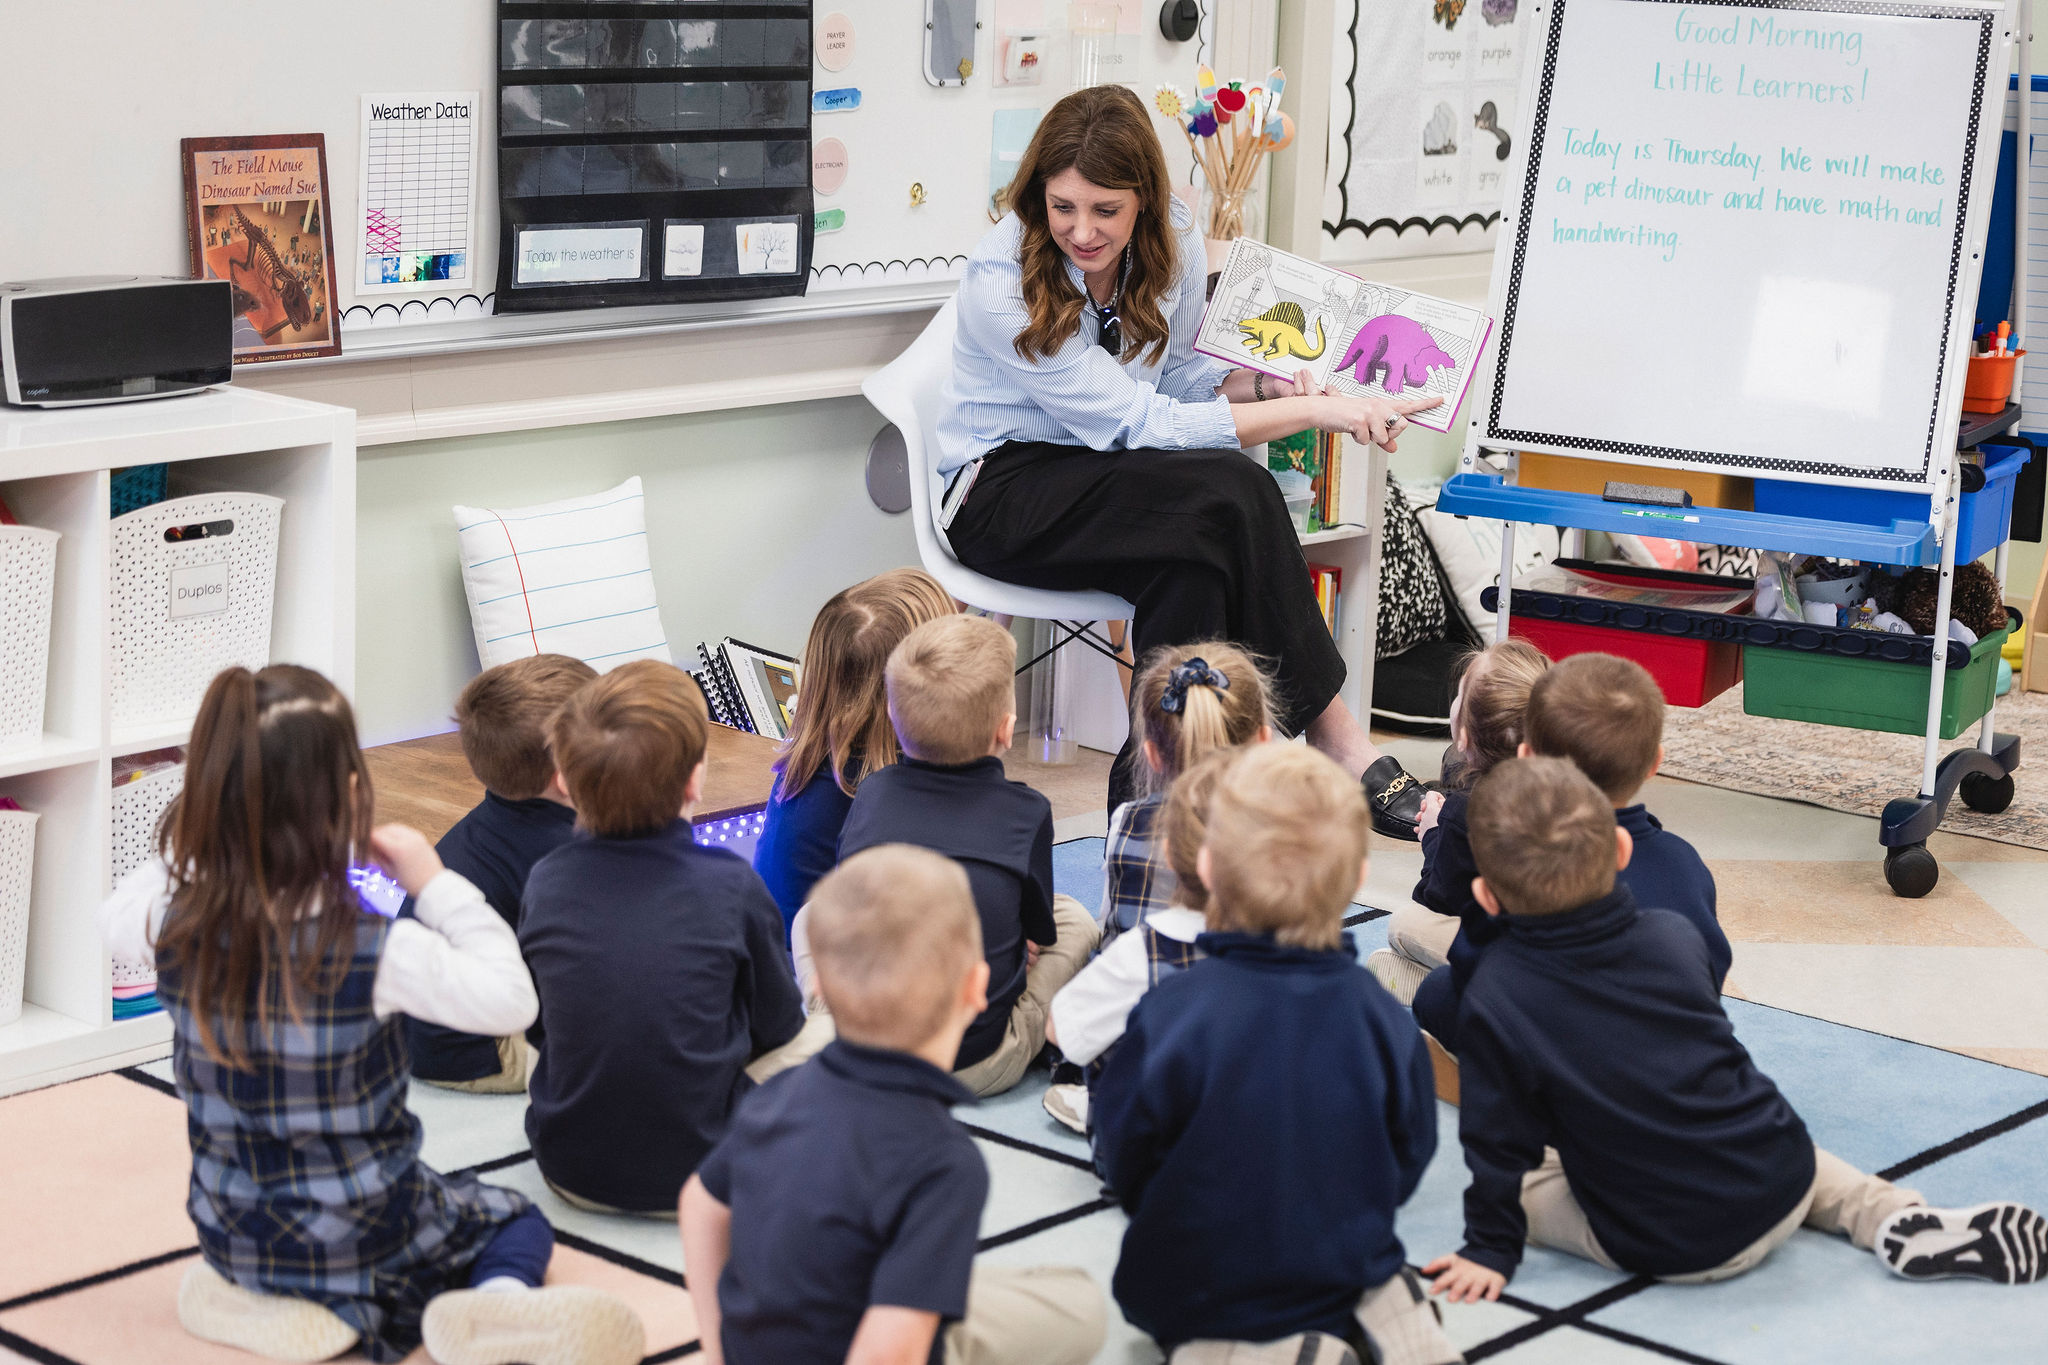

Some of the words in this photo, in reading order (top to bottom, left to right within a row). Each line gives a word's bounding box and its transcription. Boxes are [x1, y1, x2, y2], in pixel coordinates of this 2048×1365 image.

[826, 42, 846, 50] LEADER
[1675, 7, 1740, 45] Good
[1749, 16, 1863, 66] Morning
[1428, 51, 1462, 69] orange
[1482, 42, 1512, 66] purple
[1653, 59, 1723, 95] Little
[1737, 64, 1869, 112] Learners!
[371, 102, 432, 120] Weather
[436, 101, 468, 119] Data
[824, 96, 848, 106] Cooper
[212, 157, 232, 176] The
[237, 155, 266, 175] Field
[268, 159, 304, 173] Mouse
[1562, 126, 1622, 171] Today
[1634, 139, 1654, 160] is
[1663, 138, 1766, 182] Thursday.
[1780, 146, 1812, 172] We
[1825, 154, 1870, 178] will
[1880, 161, 1945, 186] make
[815, 162, 844, 170] ELECTRICIAN
[1424, 168, 1453, 187] white
[1479, 171, 1501, 190] gray
[201, 184, 250, 200] Dinosaur
[253, 177, 294, 197] Named
[296, 180, 317, 194] Sue
[1556, 176, 1572, 194] a
[1584, 175, 1618, 206] pet
[1624, 177, 1714, 206] dinosaur
[1723, 186, 1765, 210] and
[1775, 188, 1827, 215] have
[1839, 195, 1899, 223] math
[1906, 198, 1944, 228] and
[1553, 218, 1683, 263] handwriting.
[525, 249, 558, 263] Today
[561, 249, 578, 261] the
[580, 248, 624, 260] weather
[628, 248, 635, 260] is
[178, 584, 222, 600] Duplos
